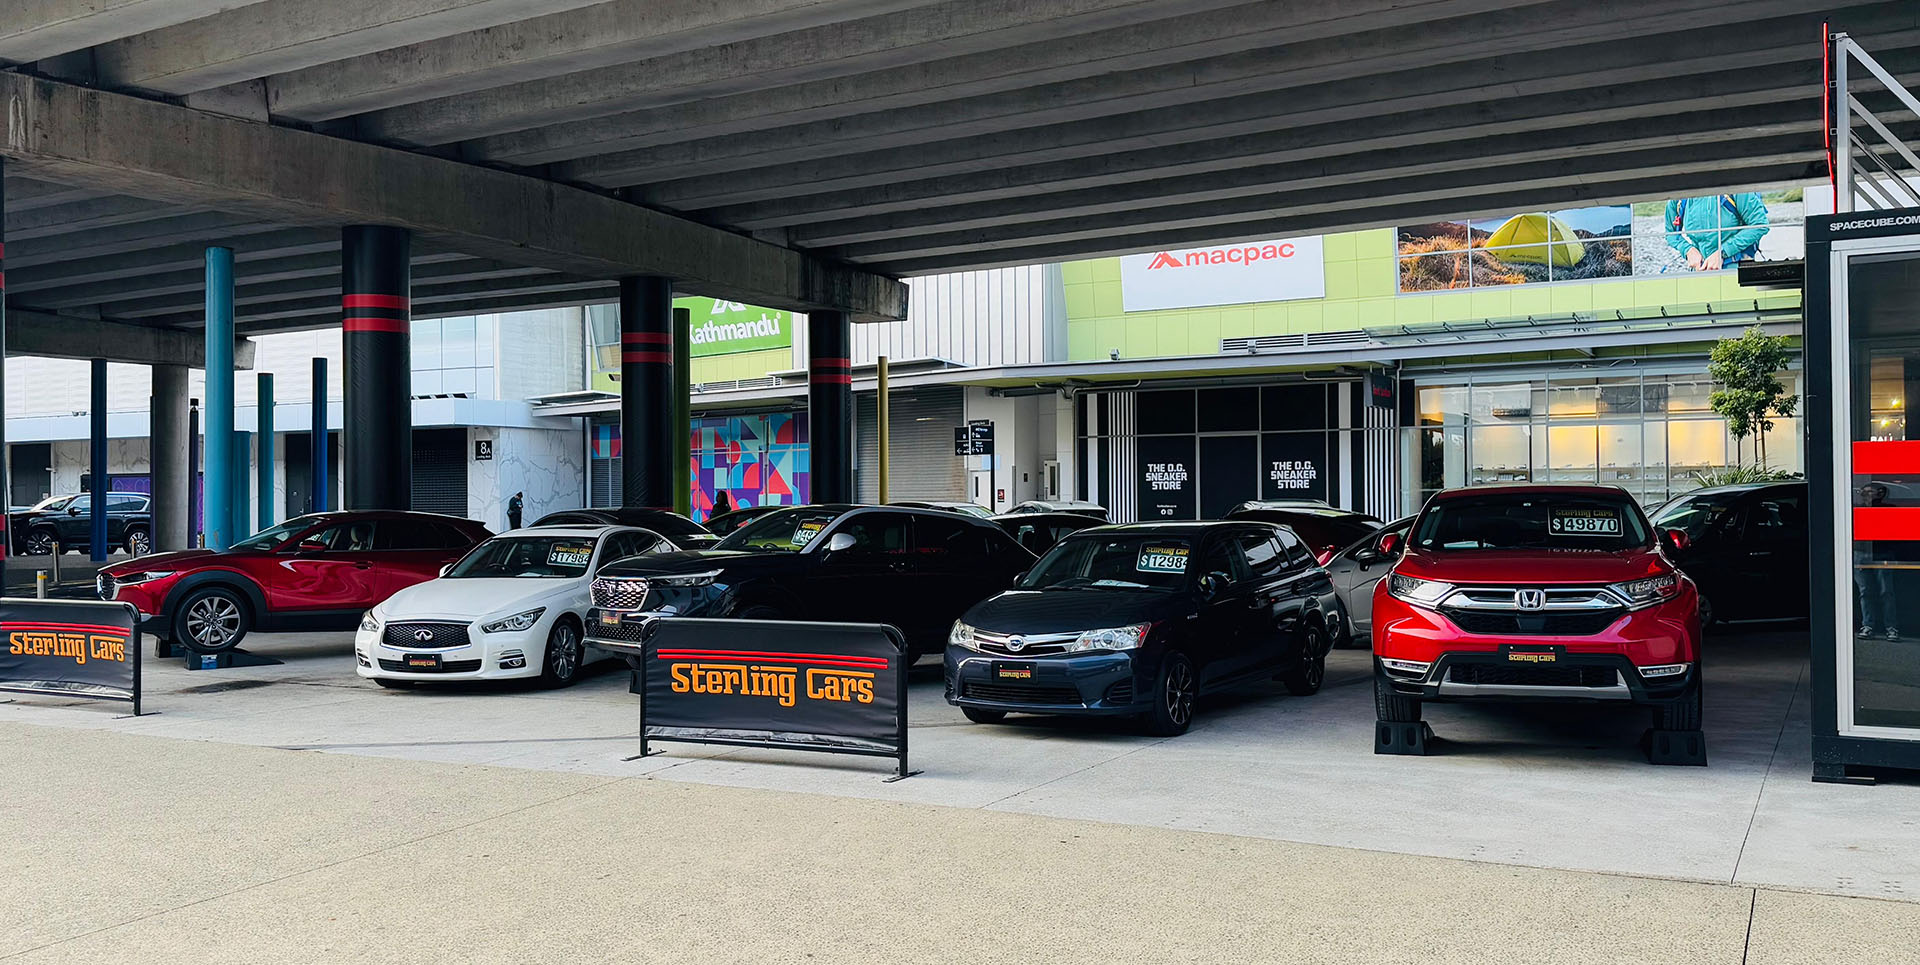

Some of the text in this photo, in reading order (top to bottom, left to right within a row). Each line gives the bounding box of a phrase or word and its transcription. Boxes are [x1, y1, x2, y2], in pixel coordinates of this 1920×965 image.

[1830, 215, 1920, 231] SPACECUBE.COM
[1185, 243, 1295, 266] macpac
[1148, 463, 1186, 472] THE O.G.
[1272, 461, 1314, 471] THE O.G.
[1145, 472, 1187, 481] SNEAKER
[1270, 470, 1317, 480] SNEAKER
[1152, 481, 1182, 490] STORE
[1277, 479, 1310, 489] STORE
[9, 632, 126, 665] Sterling Cars
[670, 663, 875, 707] Sterling Cars
